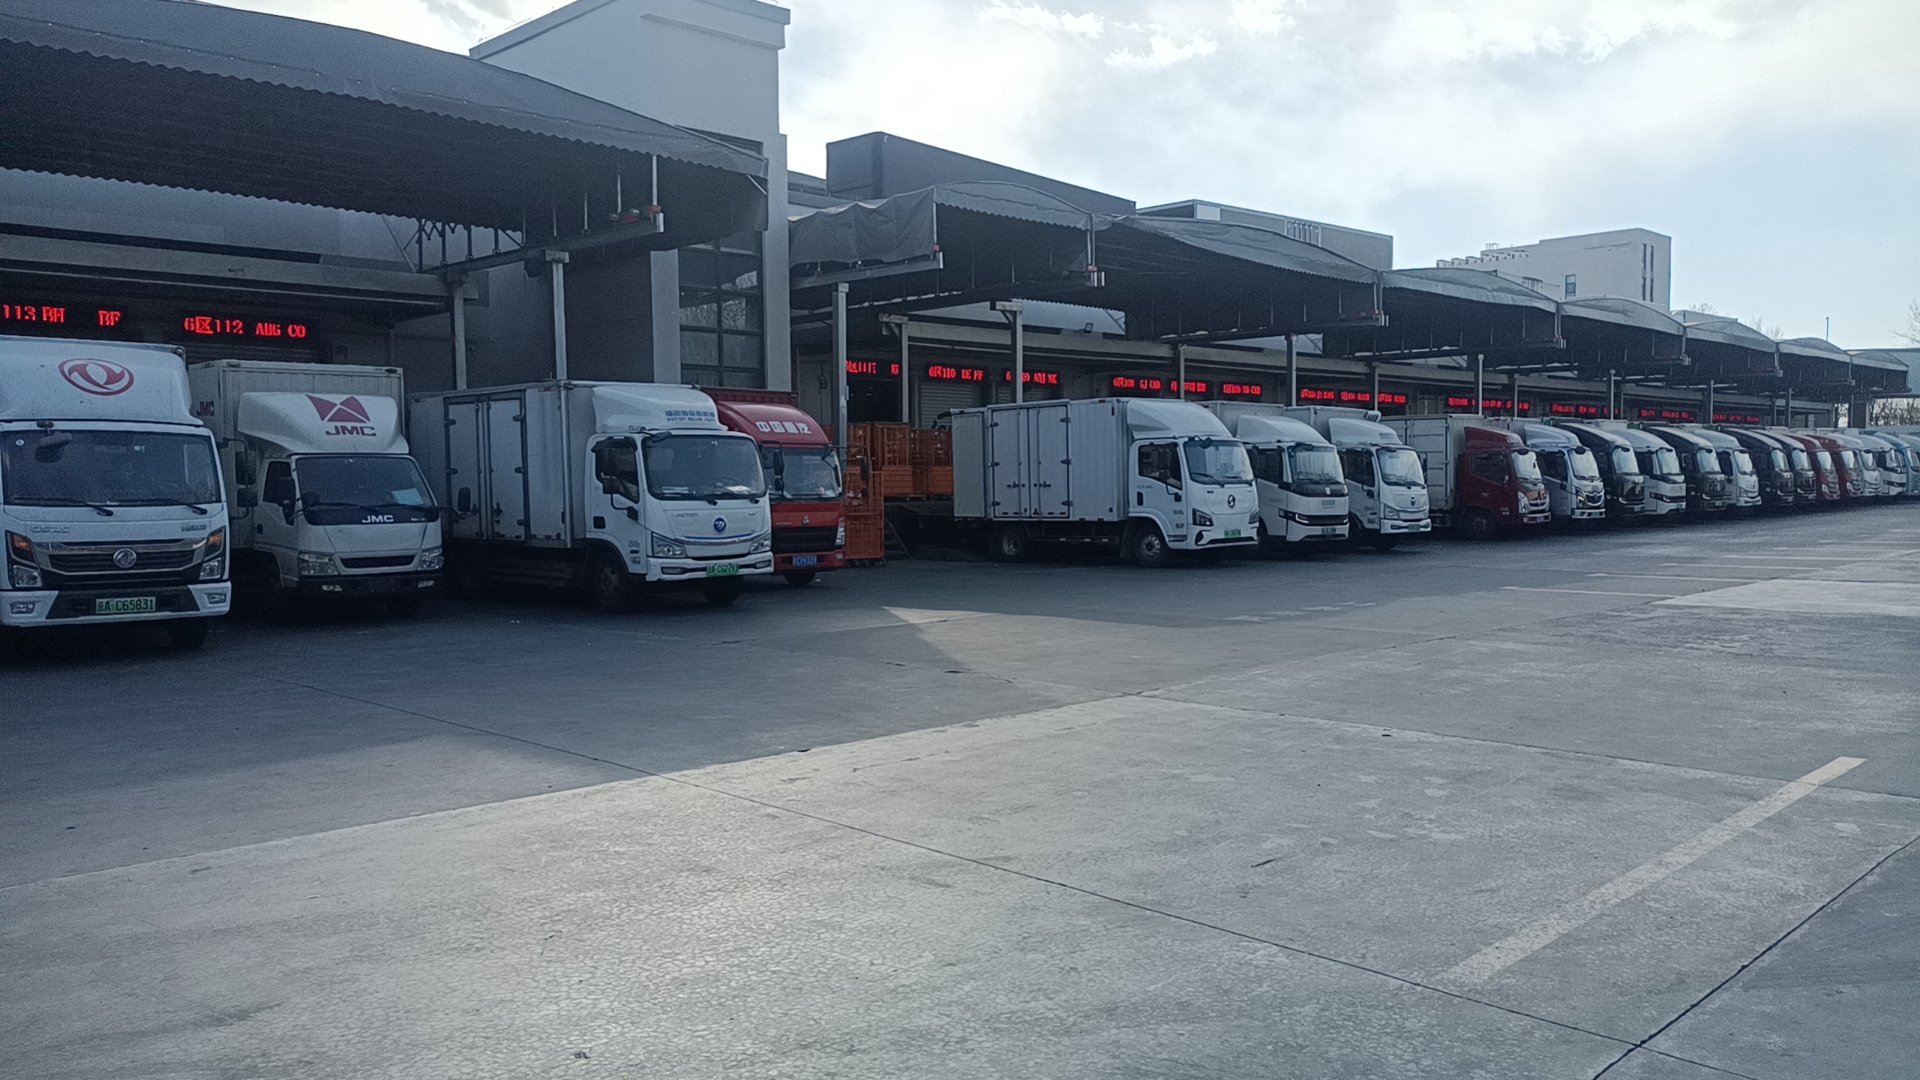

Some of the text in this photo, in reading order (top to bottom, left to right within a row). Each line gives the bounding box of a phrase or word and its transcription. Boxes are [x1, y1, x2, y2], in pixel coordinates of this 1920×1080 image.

[196, 401, 216, 417] JMC
[325, 425, 377, 436] JMC
[362, 514, 395, 524] JMC
